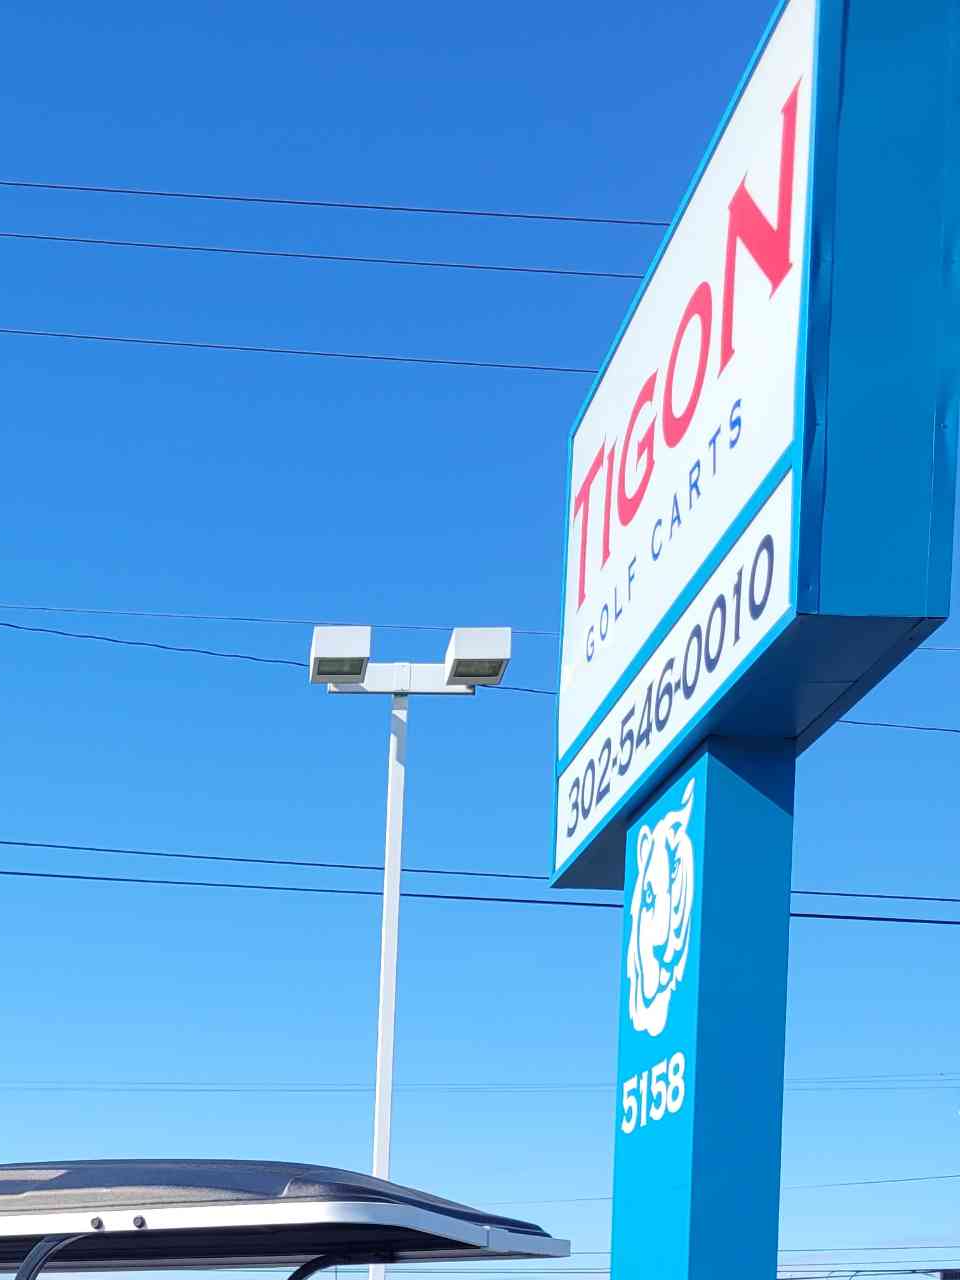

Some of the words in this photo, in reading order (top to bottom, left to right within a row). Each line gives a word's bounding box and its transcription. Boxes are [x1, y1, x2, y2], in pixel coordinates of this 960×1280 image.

[573, 79, 802, 613] TIGON
[586, 555, 638, 664] GOLF
[650, 398, 743, 562] CARTS
[566, 534, 775, 839] 302-546-0010
[621, 1051, 685, 1134] 5158
